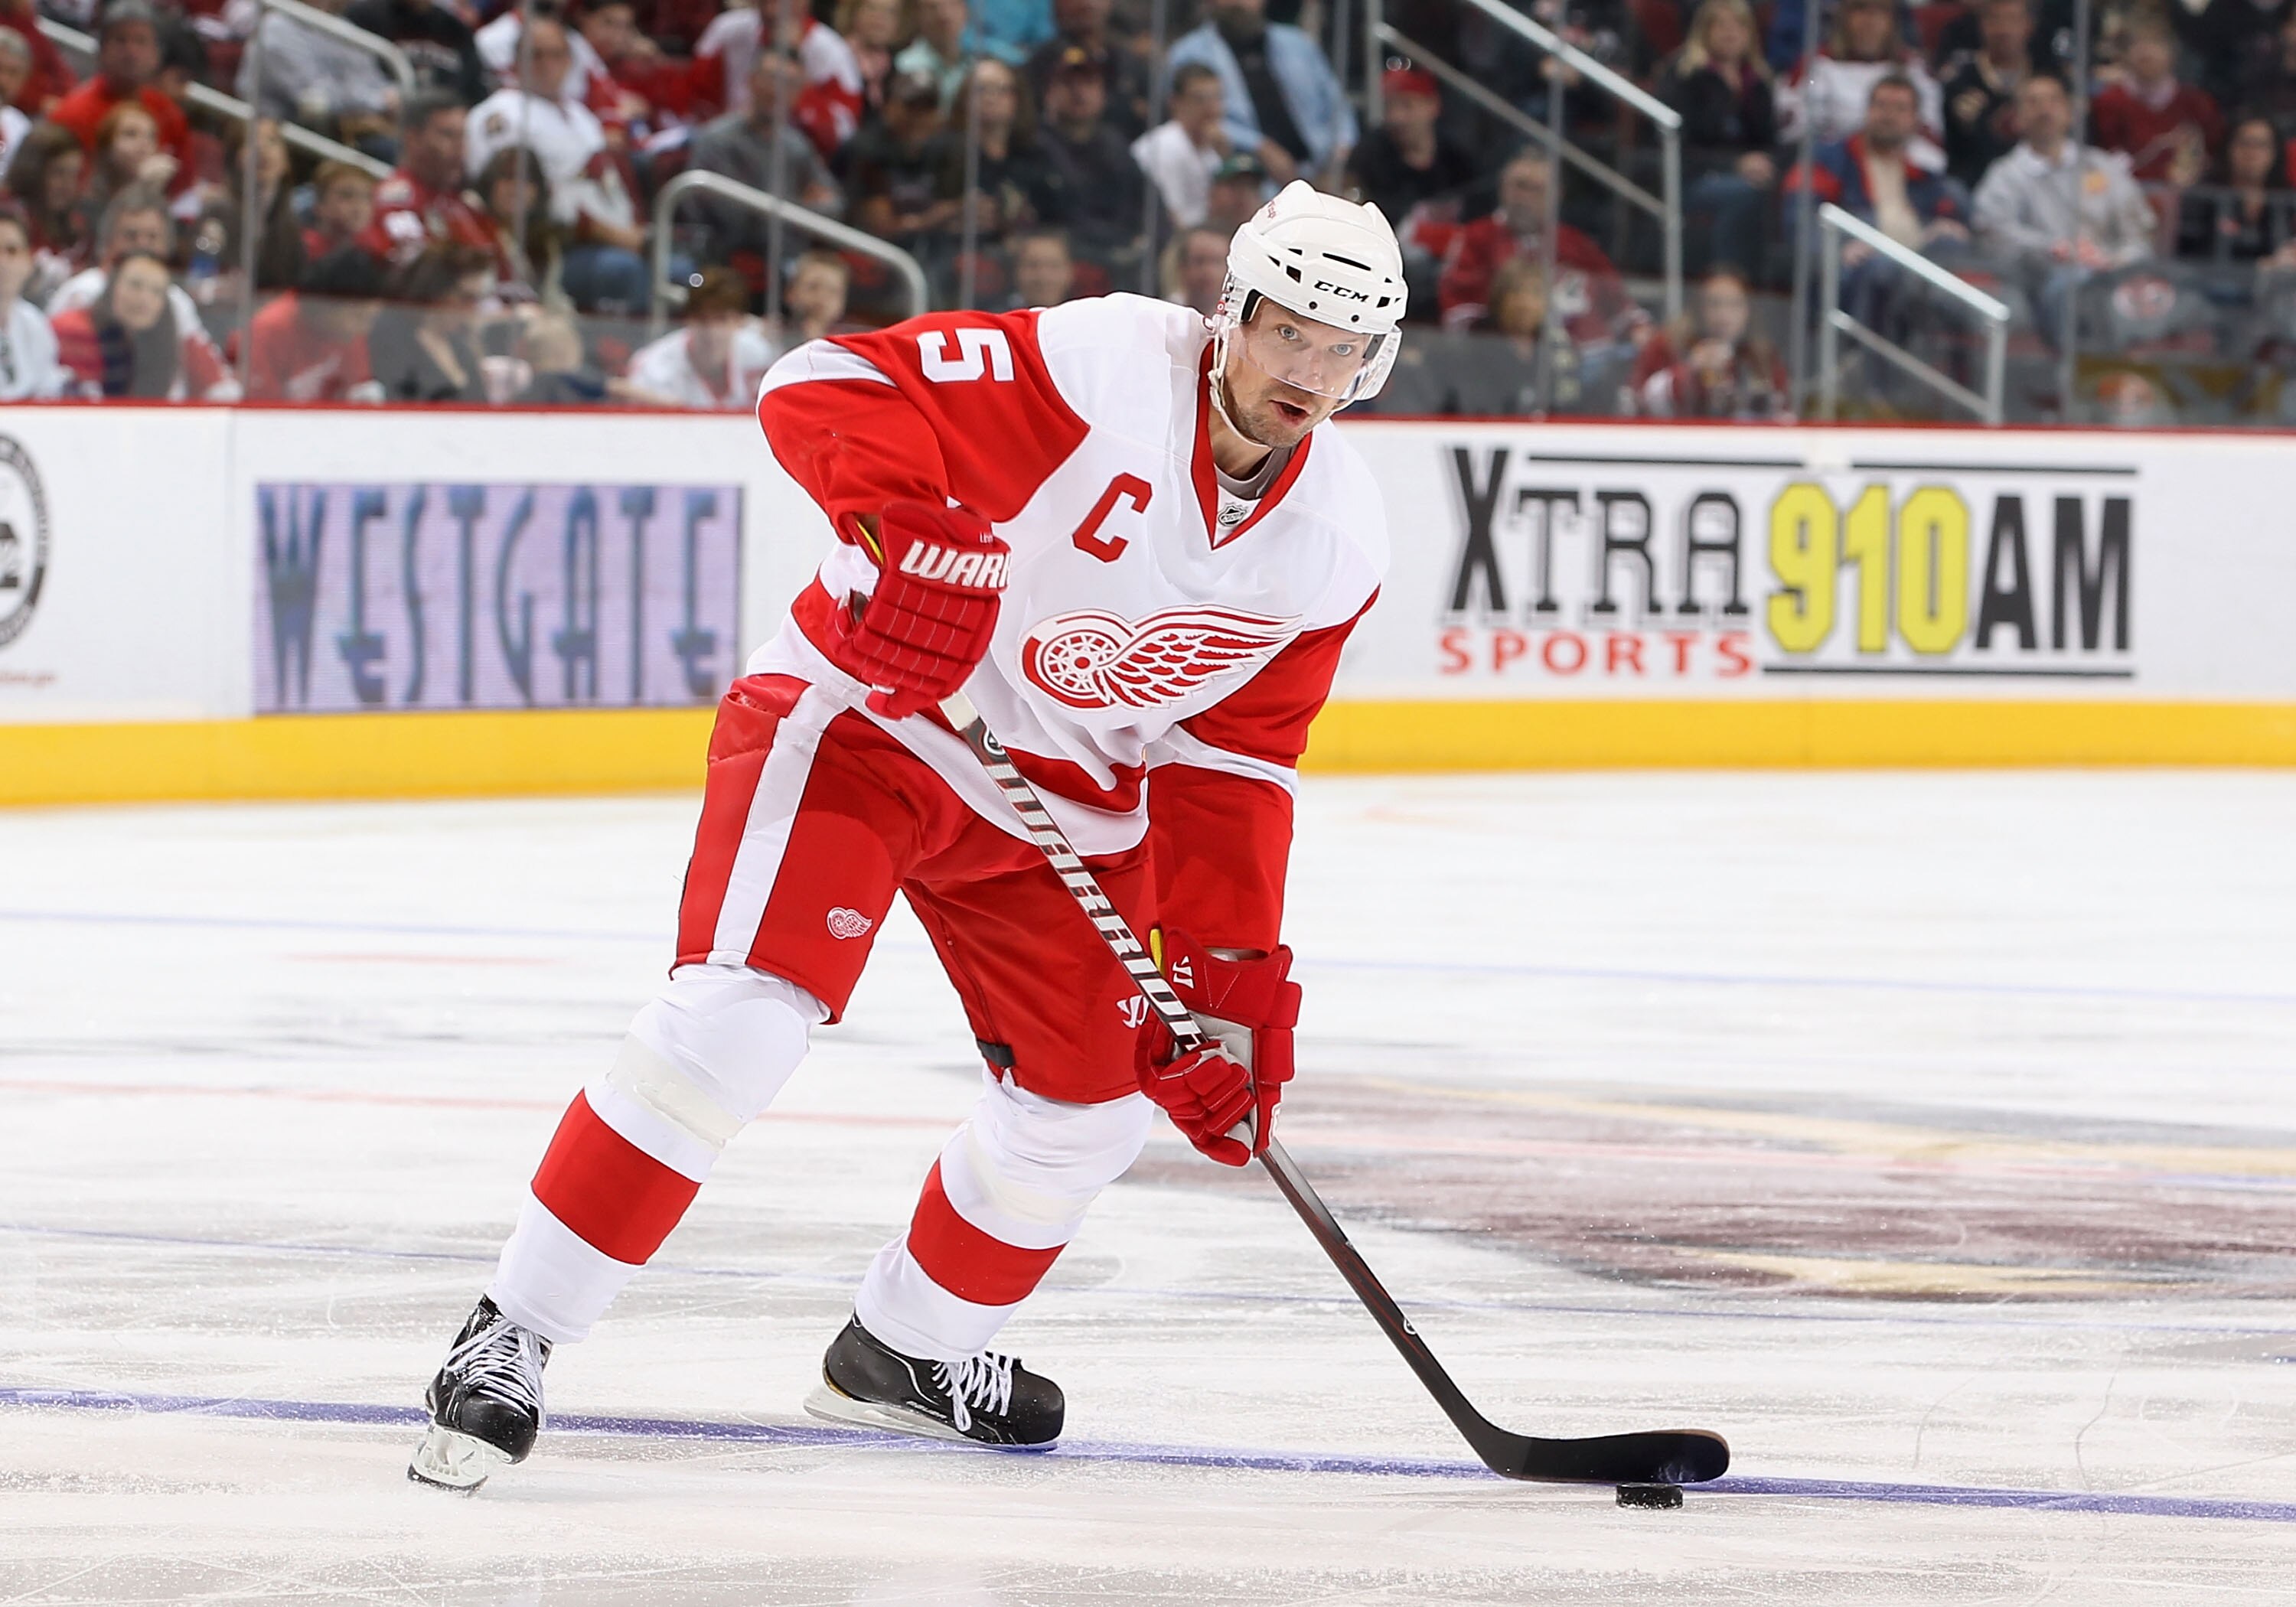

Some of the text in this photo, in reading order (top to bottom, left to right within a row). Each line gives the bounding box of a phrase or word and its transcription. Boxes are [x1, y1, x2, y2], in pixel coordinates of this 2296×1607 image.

[1313, 279, 1369, 303] CCM
[916, 328, 1014, 383] 5
[1073, 472, 1153, 563] C
[1440, 446, 1751, 616] XTRA
[259, 484, 717, 706] WESTGATE
[1437, 627, 1757, 676] SPORTS
